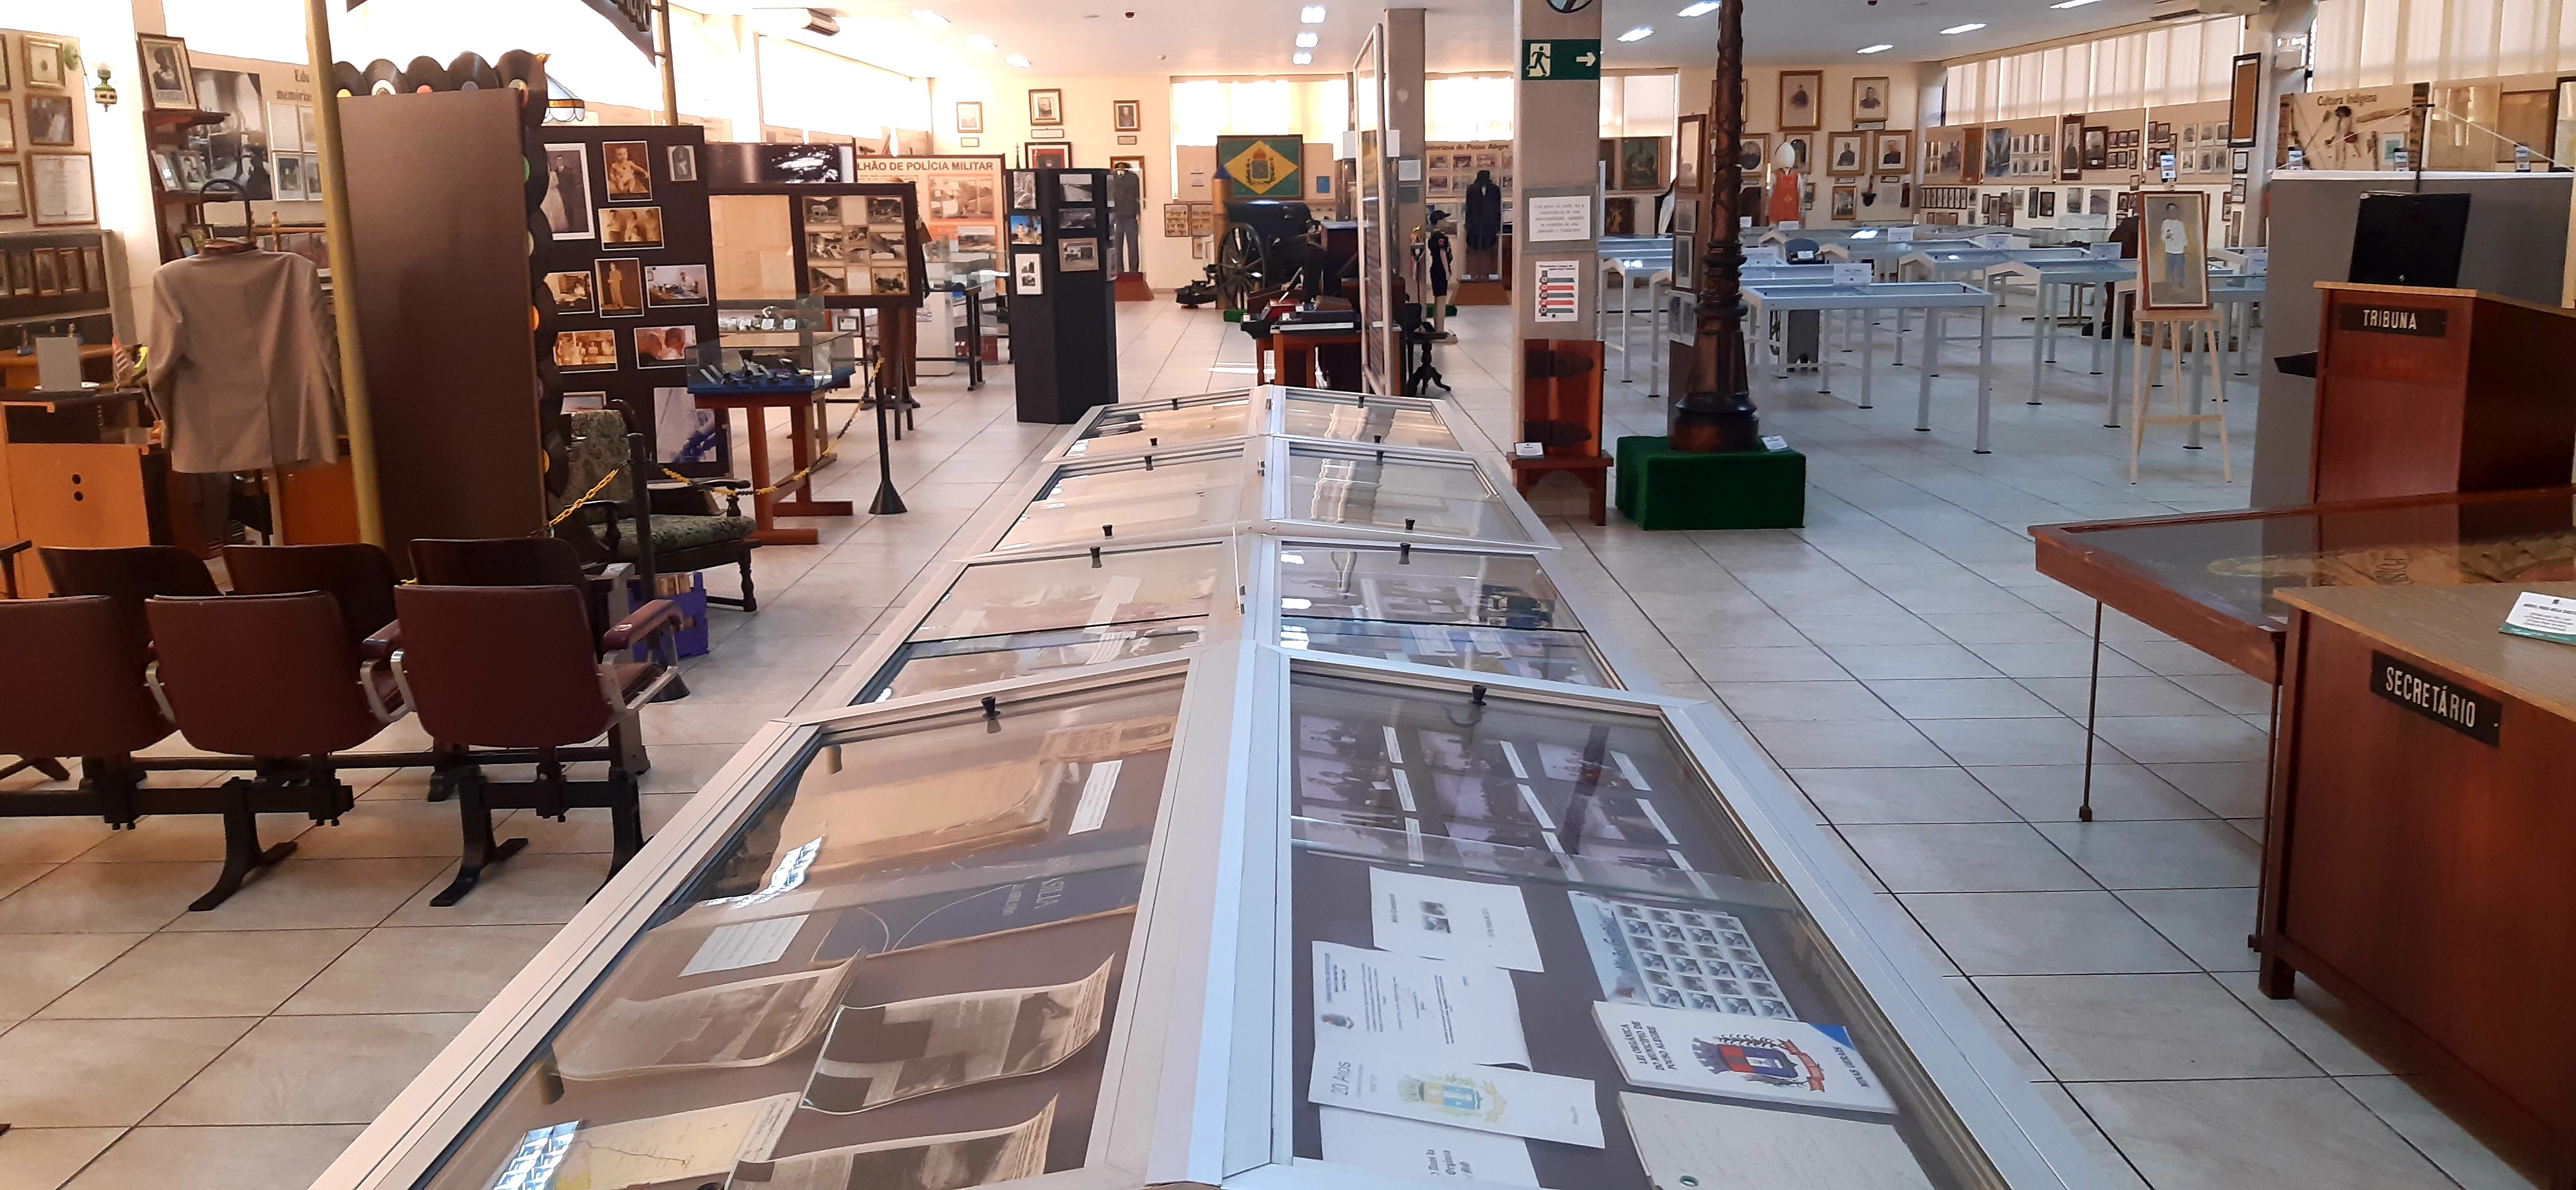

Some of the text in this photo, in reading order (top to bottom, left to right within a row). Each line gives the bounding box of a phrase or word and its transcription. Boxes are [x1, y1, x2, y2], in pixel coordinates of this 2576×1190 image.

[858, 160, 993, 171] LHÃO DE POLÍCIA MILITAR
[2363, 309, 2417, 330] TRIBUNA
[2385, 666, 2476, 728] SECRETÁRIO
[1331, 1084, 1348, 1095] 20
